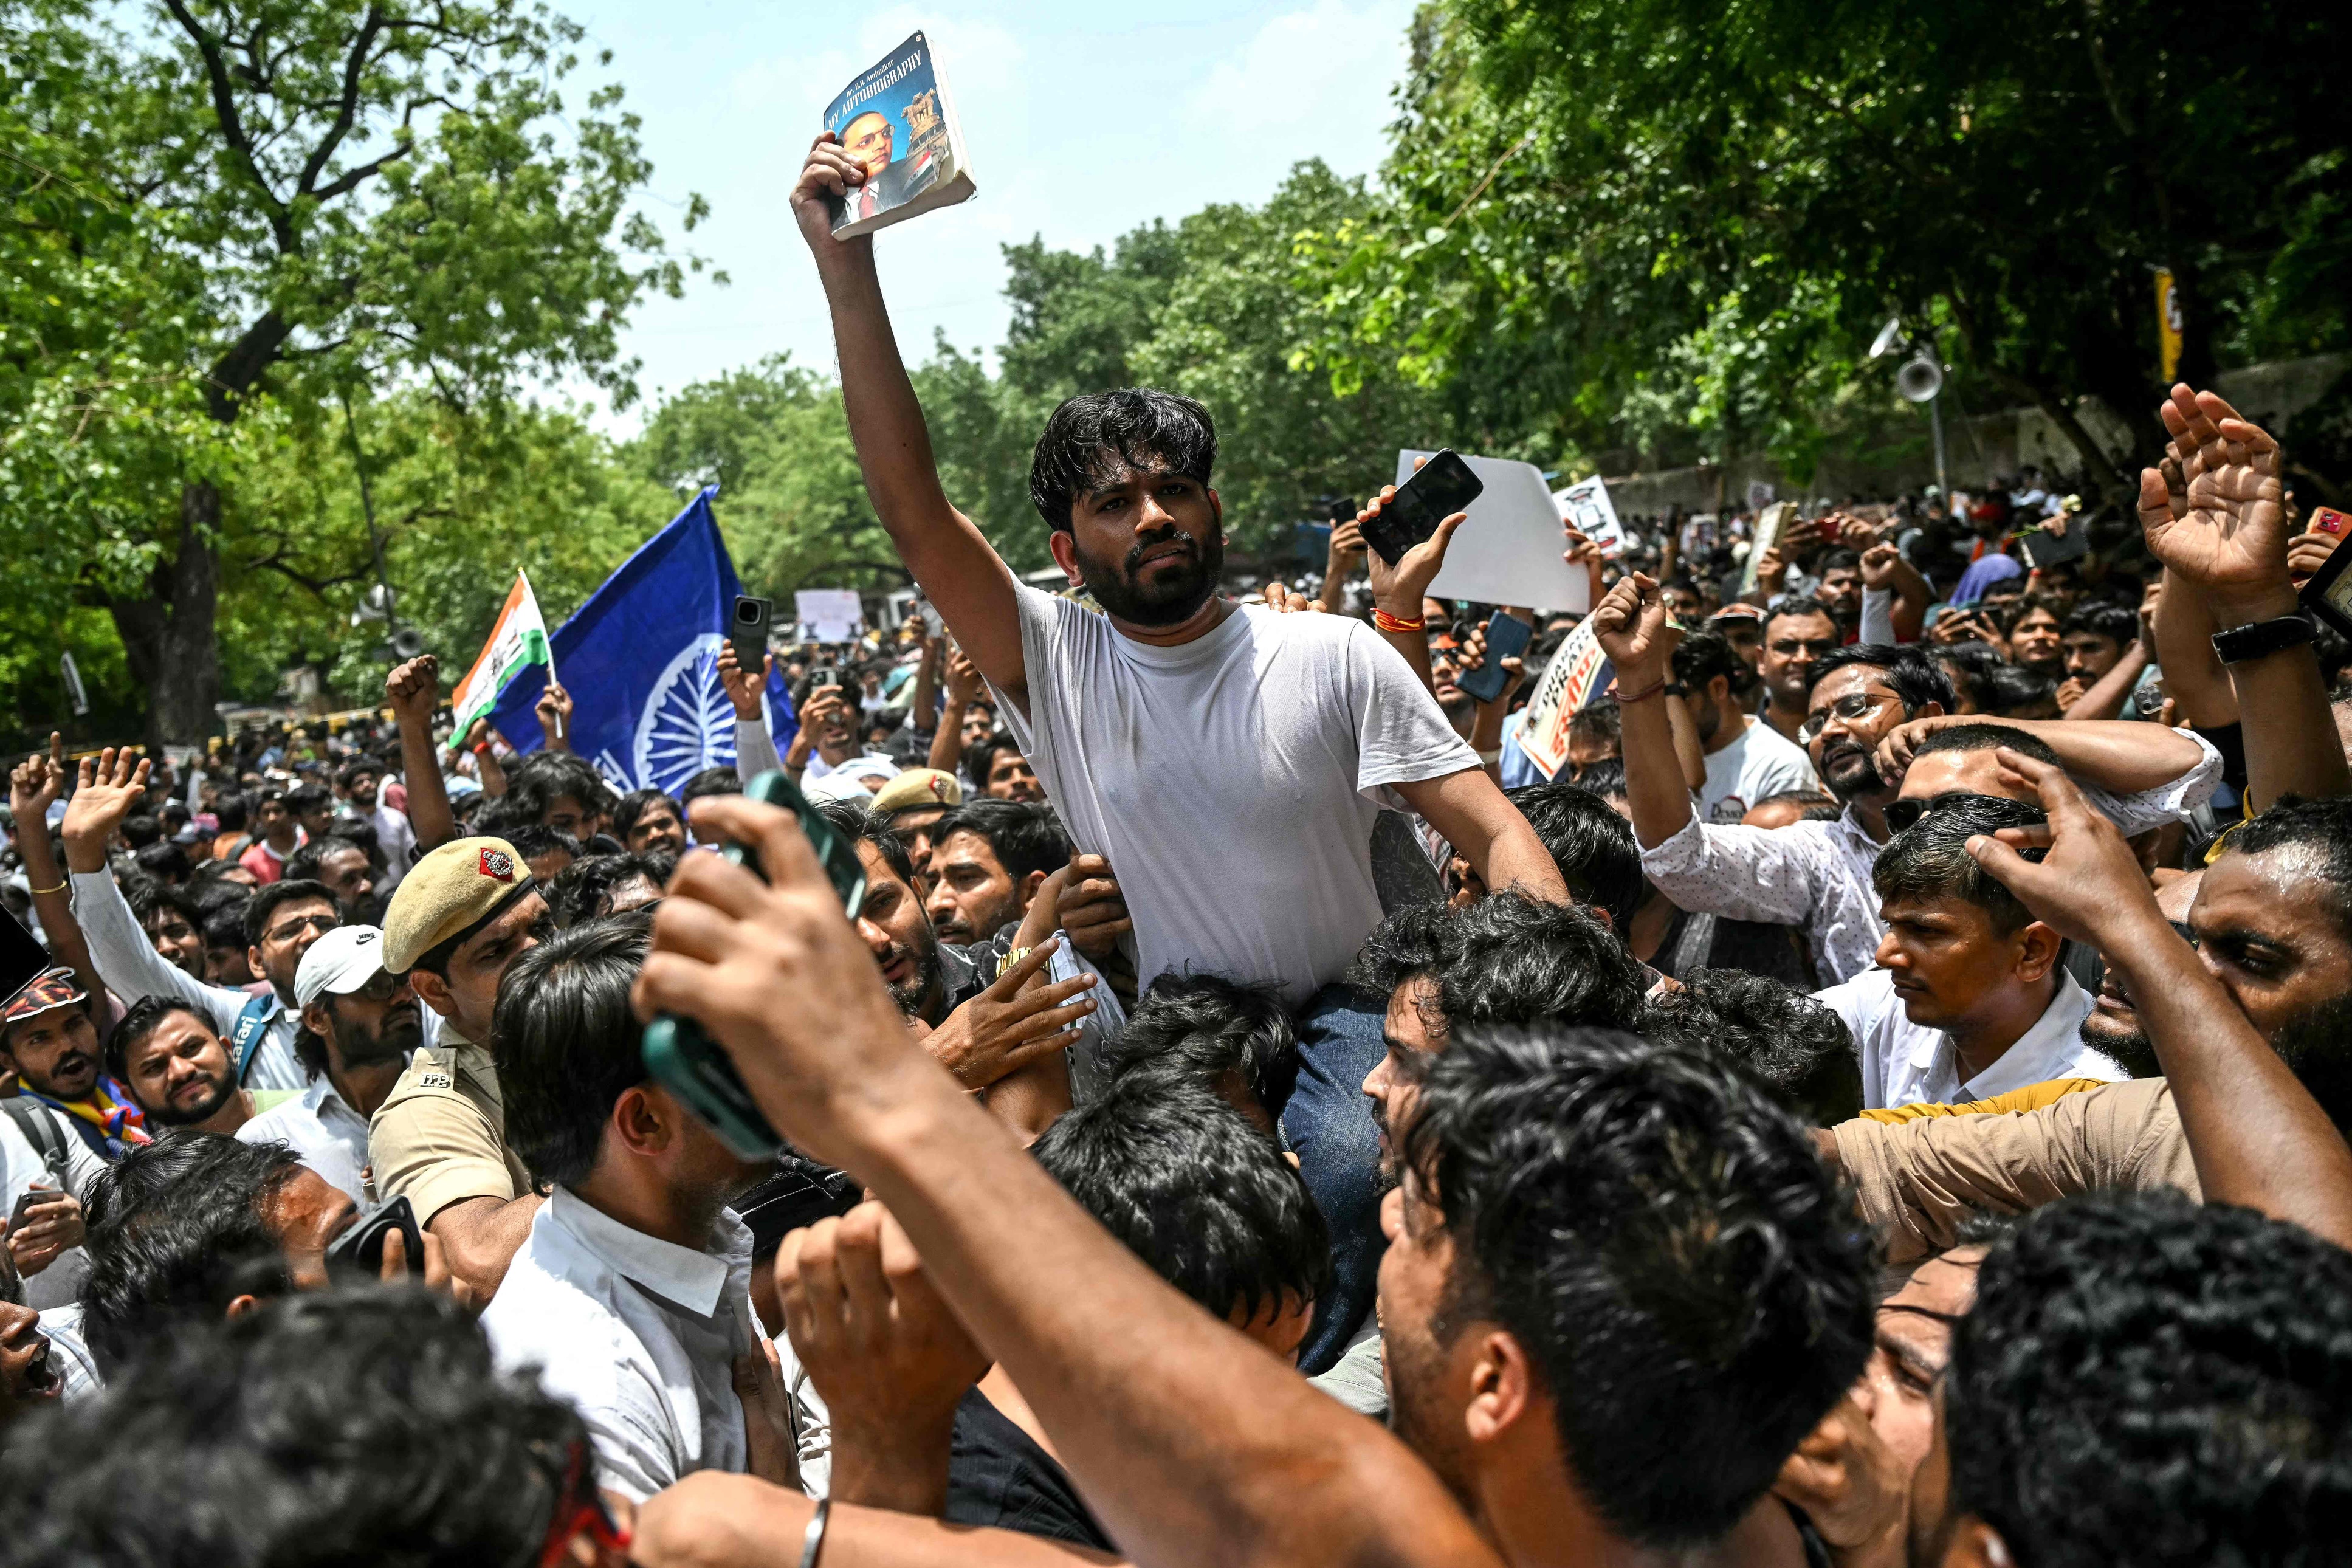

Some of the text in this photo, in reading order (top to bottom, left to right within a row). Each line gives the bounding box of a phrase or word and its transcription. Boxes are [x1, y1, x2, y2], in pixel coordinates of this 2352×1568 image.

[828, 50, 922, 129] MY AUTOBIOGRAPHY
[232, 1015, 258, 1067] safari
